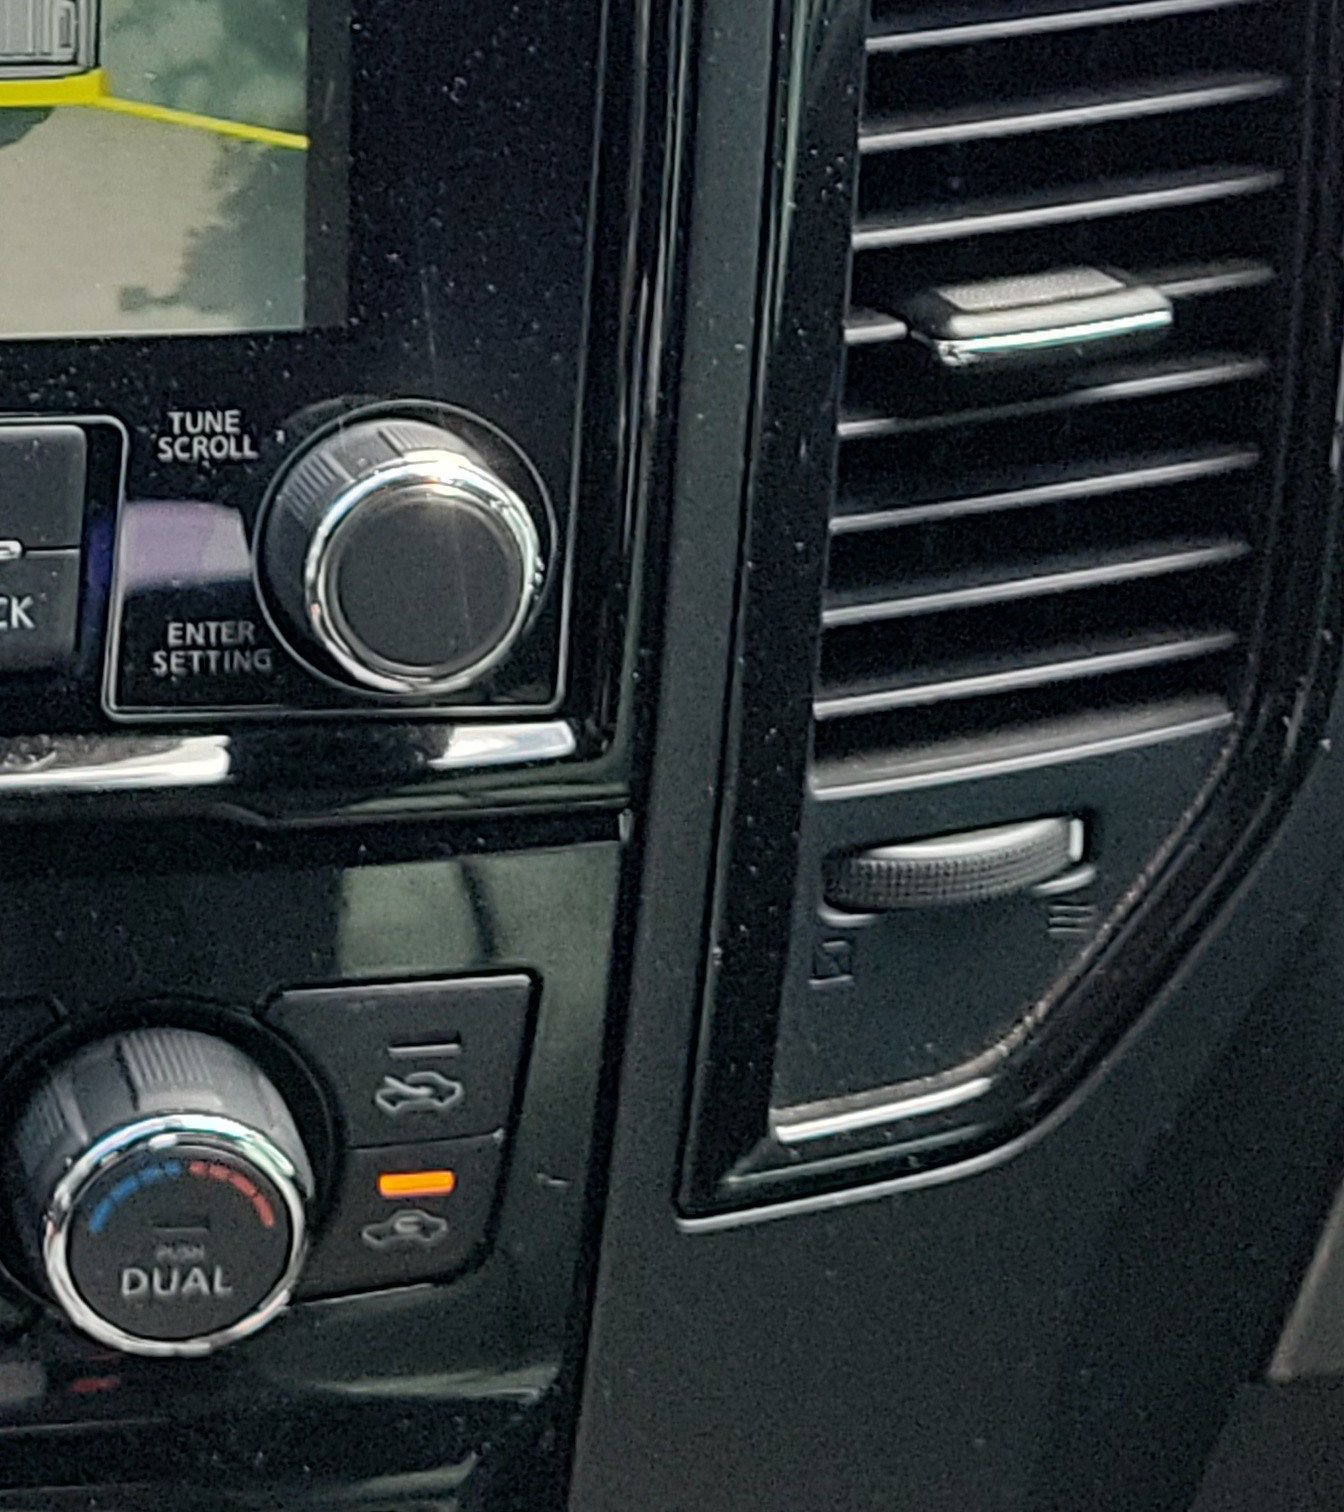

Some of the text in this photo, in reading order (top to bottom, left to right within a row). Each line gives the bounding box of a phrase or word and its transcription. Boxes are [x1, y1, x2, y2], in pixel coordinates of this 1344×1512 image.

[167, 409, 242, 434] TUNE
[157, 436, 257, 462] SCROLL
[167, 620, 255, 646] ENTER
[152, 648, 272, 676] SETTING
[121, 1266, 232, 1296] DUAL
